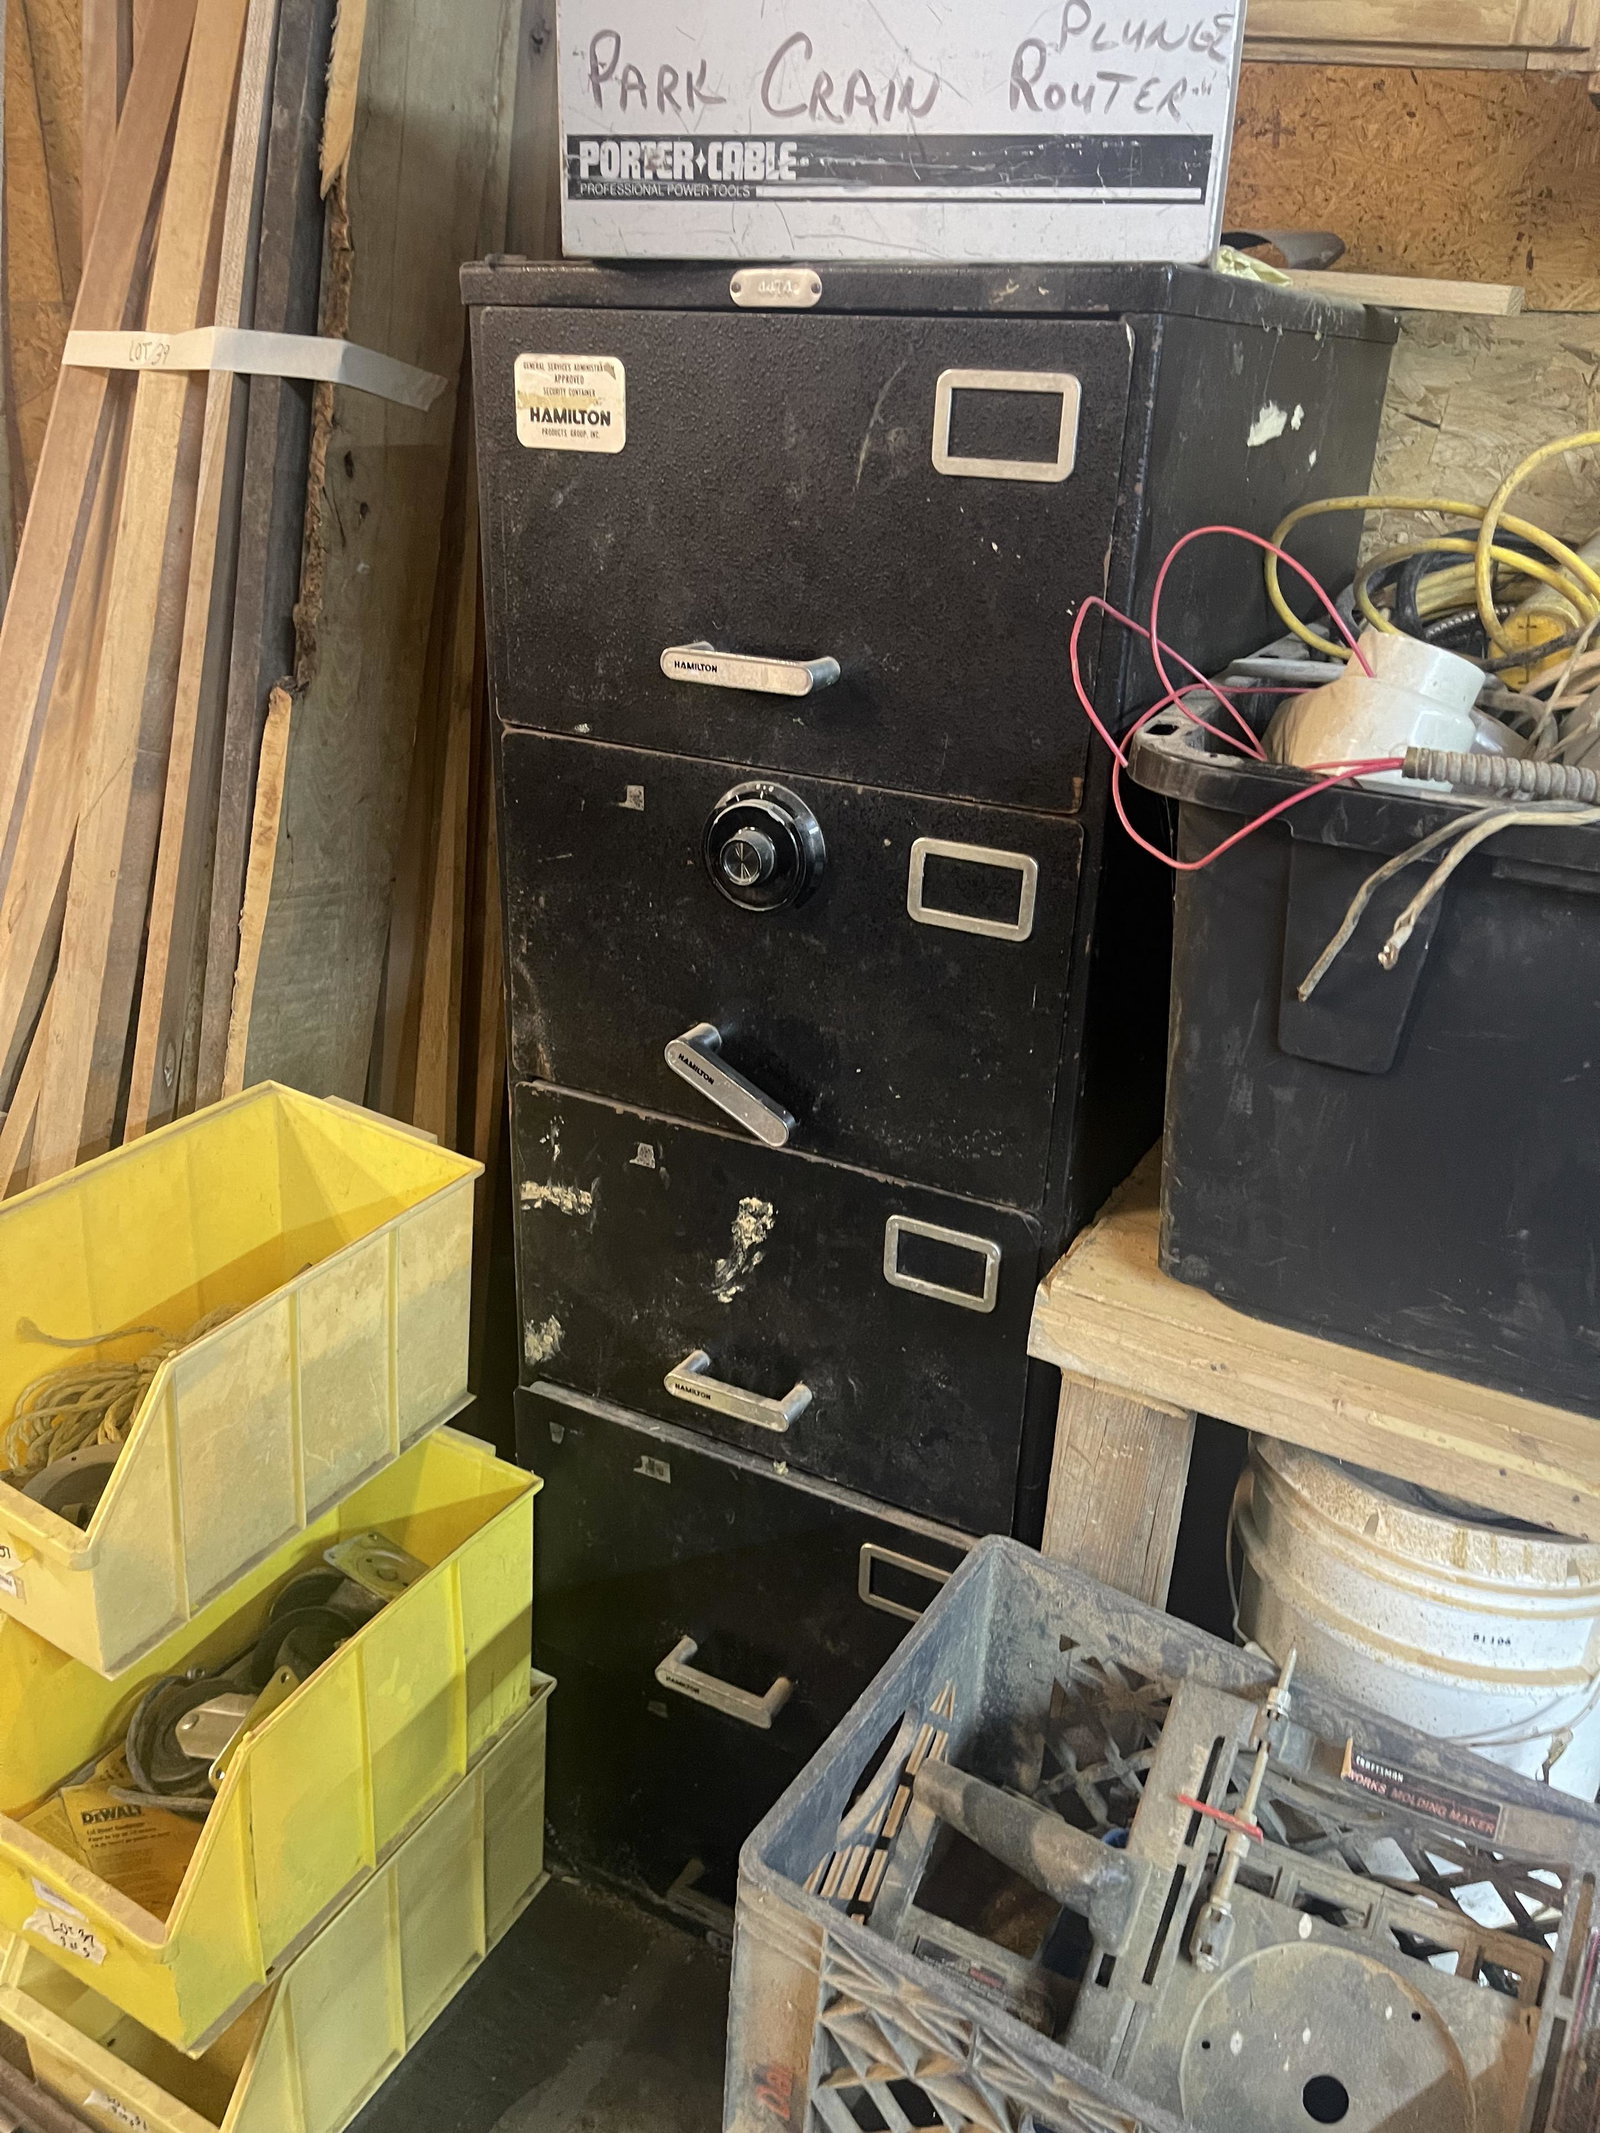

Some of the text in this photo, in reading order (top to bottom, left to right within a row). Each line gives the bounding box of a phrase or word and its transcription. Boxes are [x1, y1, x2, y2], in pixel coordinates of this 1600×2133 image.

[588, 29, 727, 114] PARK
[761, 31, 940, 125] CRAIN
[579, 141, 798, 181] PORTER CABLE
[580, 182, 751, 198] PROFESSIONAL POWER TOOLS
[523, 361, 545, 371] GENERAL
[547, 362, 572, 372] SERVICES
[554, 374, 585, 385] APPROVED
[543, 387, 596, 397] SECURITY CONTAINER
[529, 406, 611, 427] HAMILTON
[541, 428, 568, 438] PRODUCTS
[674, 660, 718, 673] HAMILTON
[678, 1053, 715, 1085] HAMILTON
[674, 1383, 711, 1400] HAMILTON
[1356, 1754, 1404, 1784] CRAFTSMAN
[1391, 1787, 1448, 1819] MOLDING
[1449, 1808, 1496, 1835] MAKER
